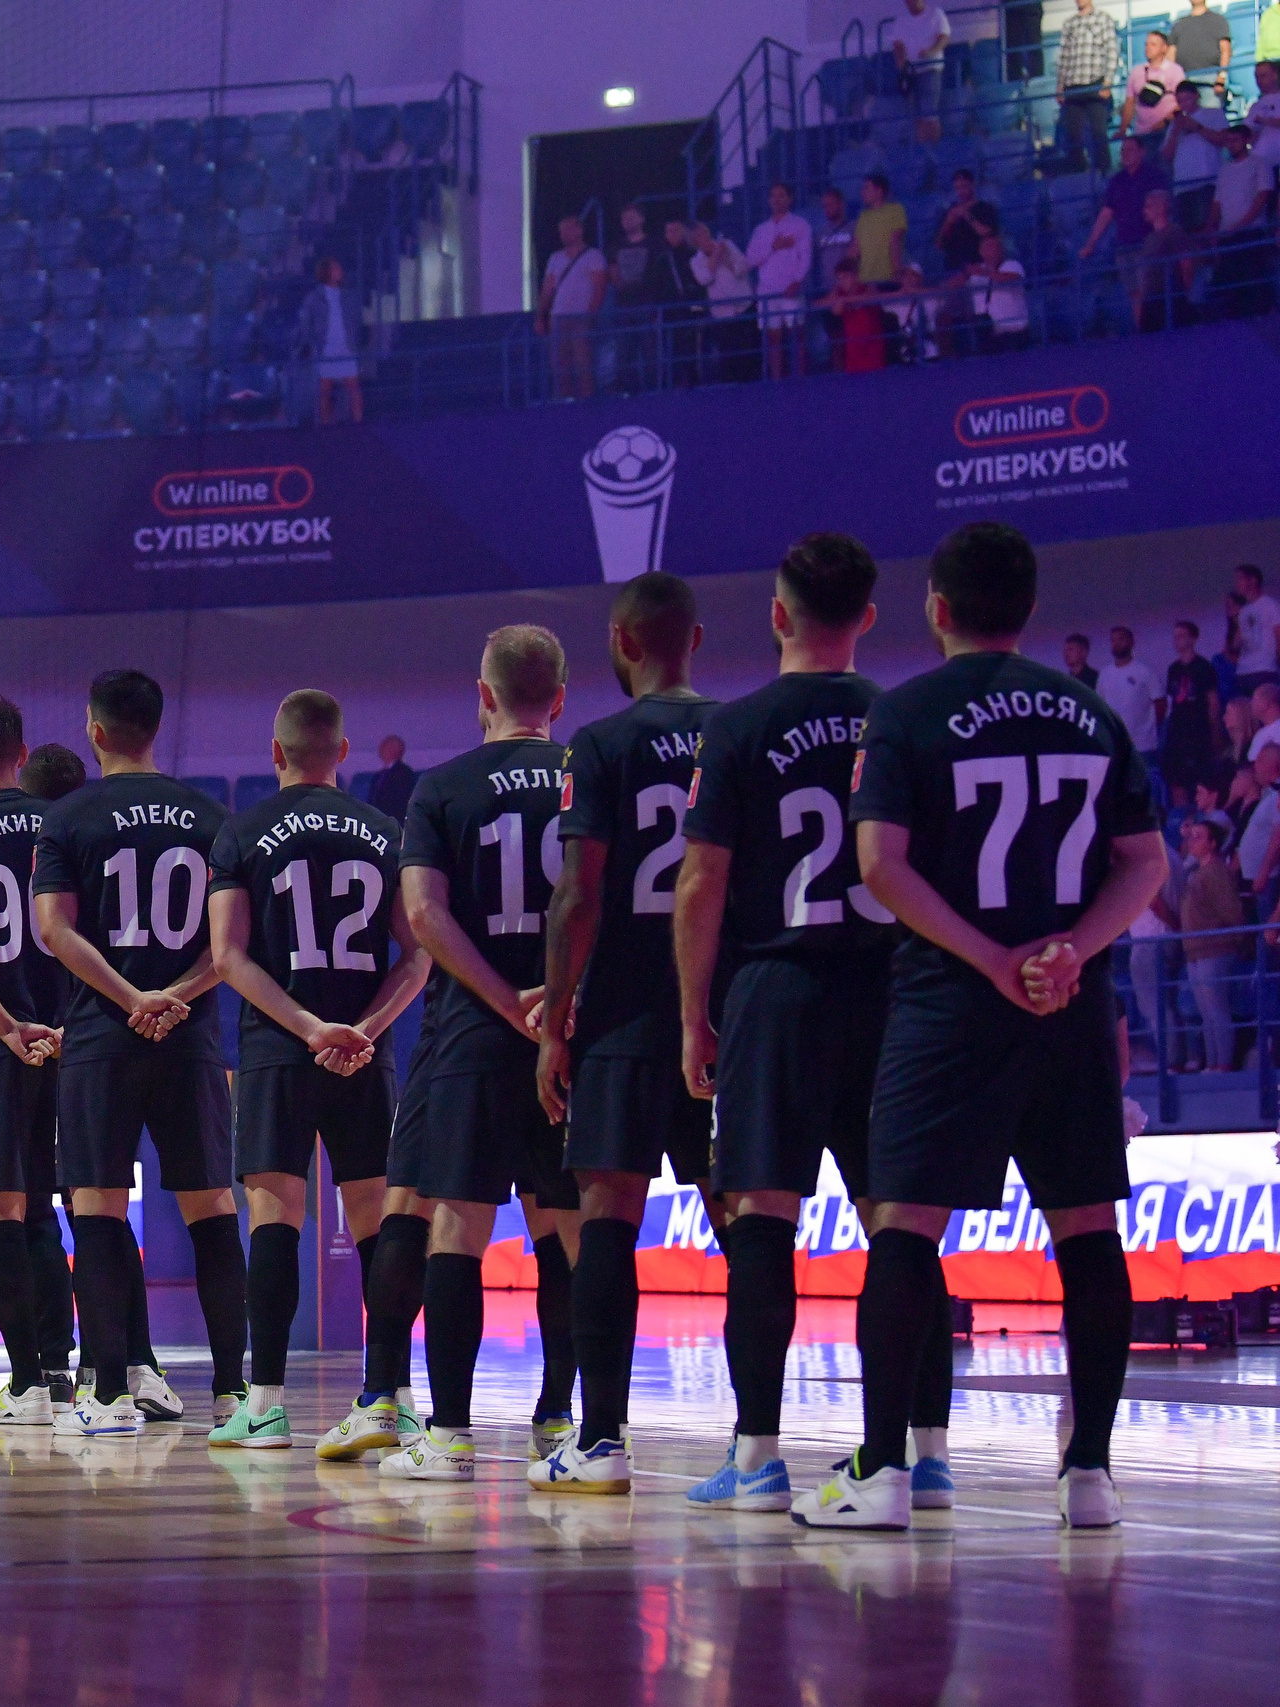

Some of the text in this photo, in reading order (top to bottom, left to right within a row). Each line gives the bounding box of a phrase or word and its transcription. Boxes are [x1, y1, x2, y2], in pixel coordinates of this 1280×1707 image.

[969, 405, 1065, 435] Winline
[935, 440, 1128, 487] СУПЕРКУБОК
[169, 480, 268, 505] Winline
[134, 516, 332, 551] СУПЕРКУБОК
[947, 690, 1098, 738] САНОСЯН
[112, 804, 195, 831] АЛЕКС
[257, 812, 389, 856] ЛЕЙФЕЛЬД
[952, 754, 1110, 909] 77
[779, 786, 897, 928] 2
[104, 846, 207, 950] 10
[272, 859, 384, 972] 12
[1176, 1184, 1280, 1253] СЛА
